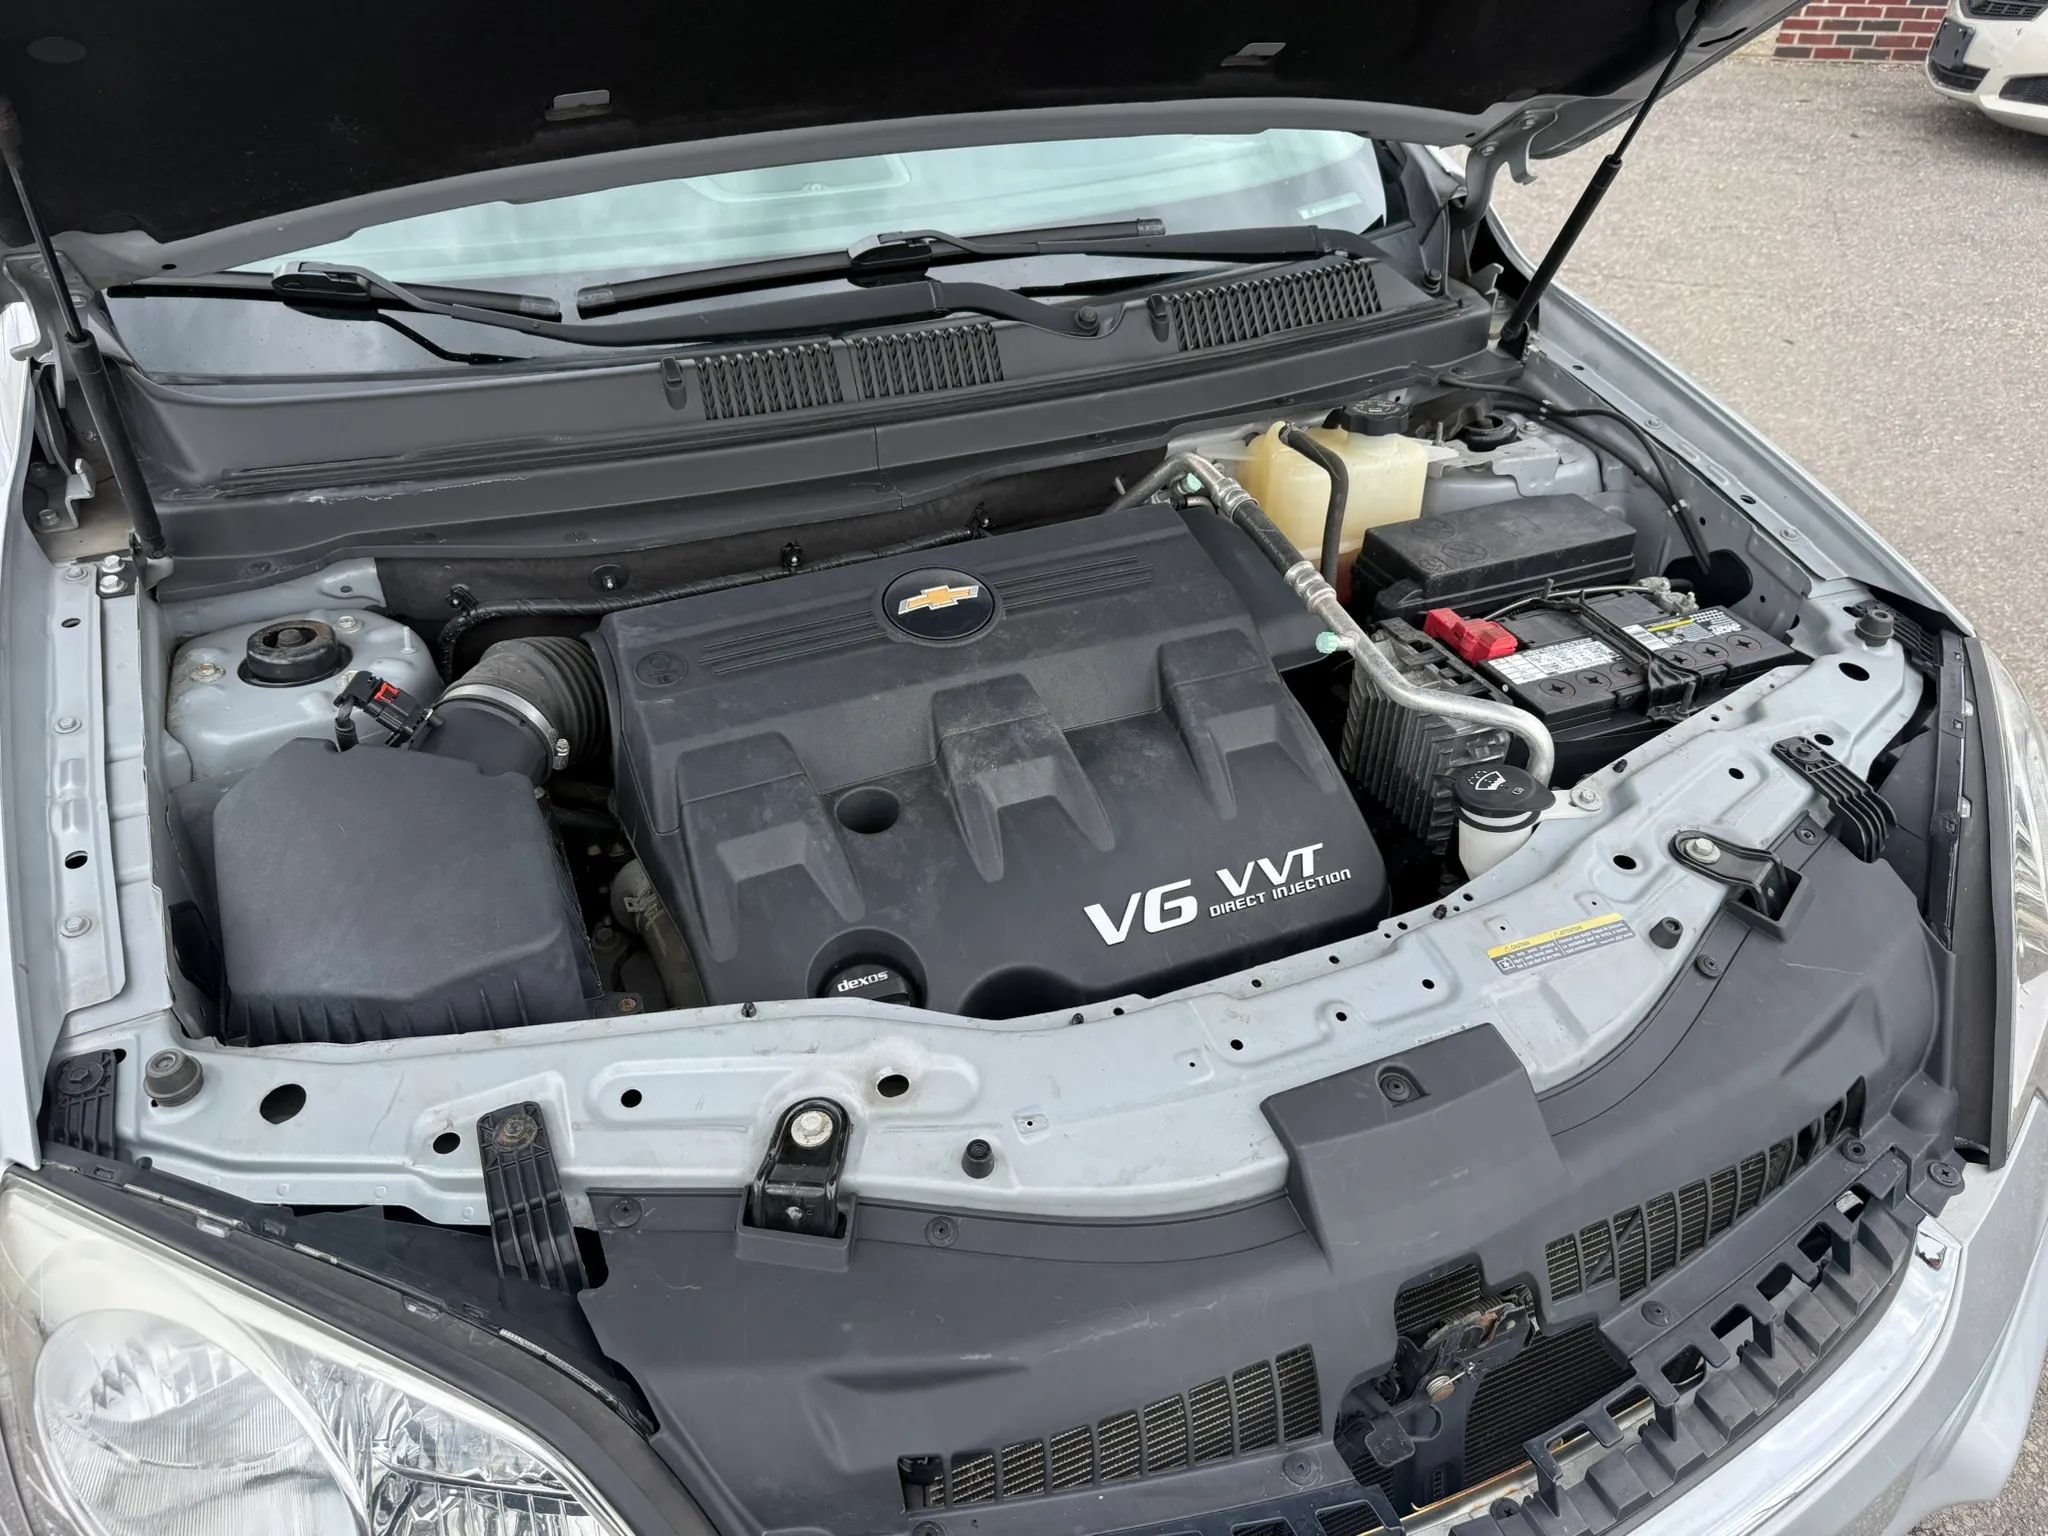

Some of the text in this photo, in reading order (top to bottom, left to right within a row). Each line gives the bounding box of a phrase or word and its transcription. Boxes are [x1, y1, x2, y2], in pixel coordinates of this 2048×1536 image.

[1083, 842, 1324, 946] V6 VVT
[1209, 868, 1352, 918] DIRECT INJECTION
[837, 970, 889, 992] dexos
